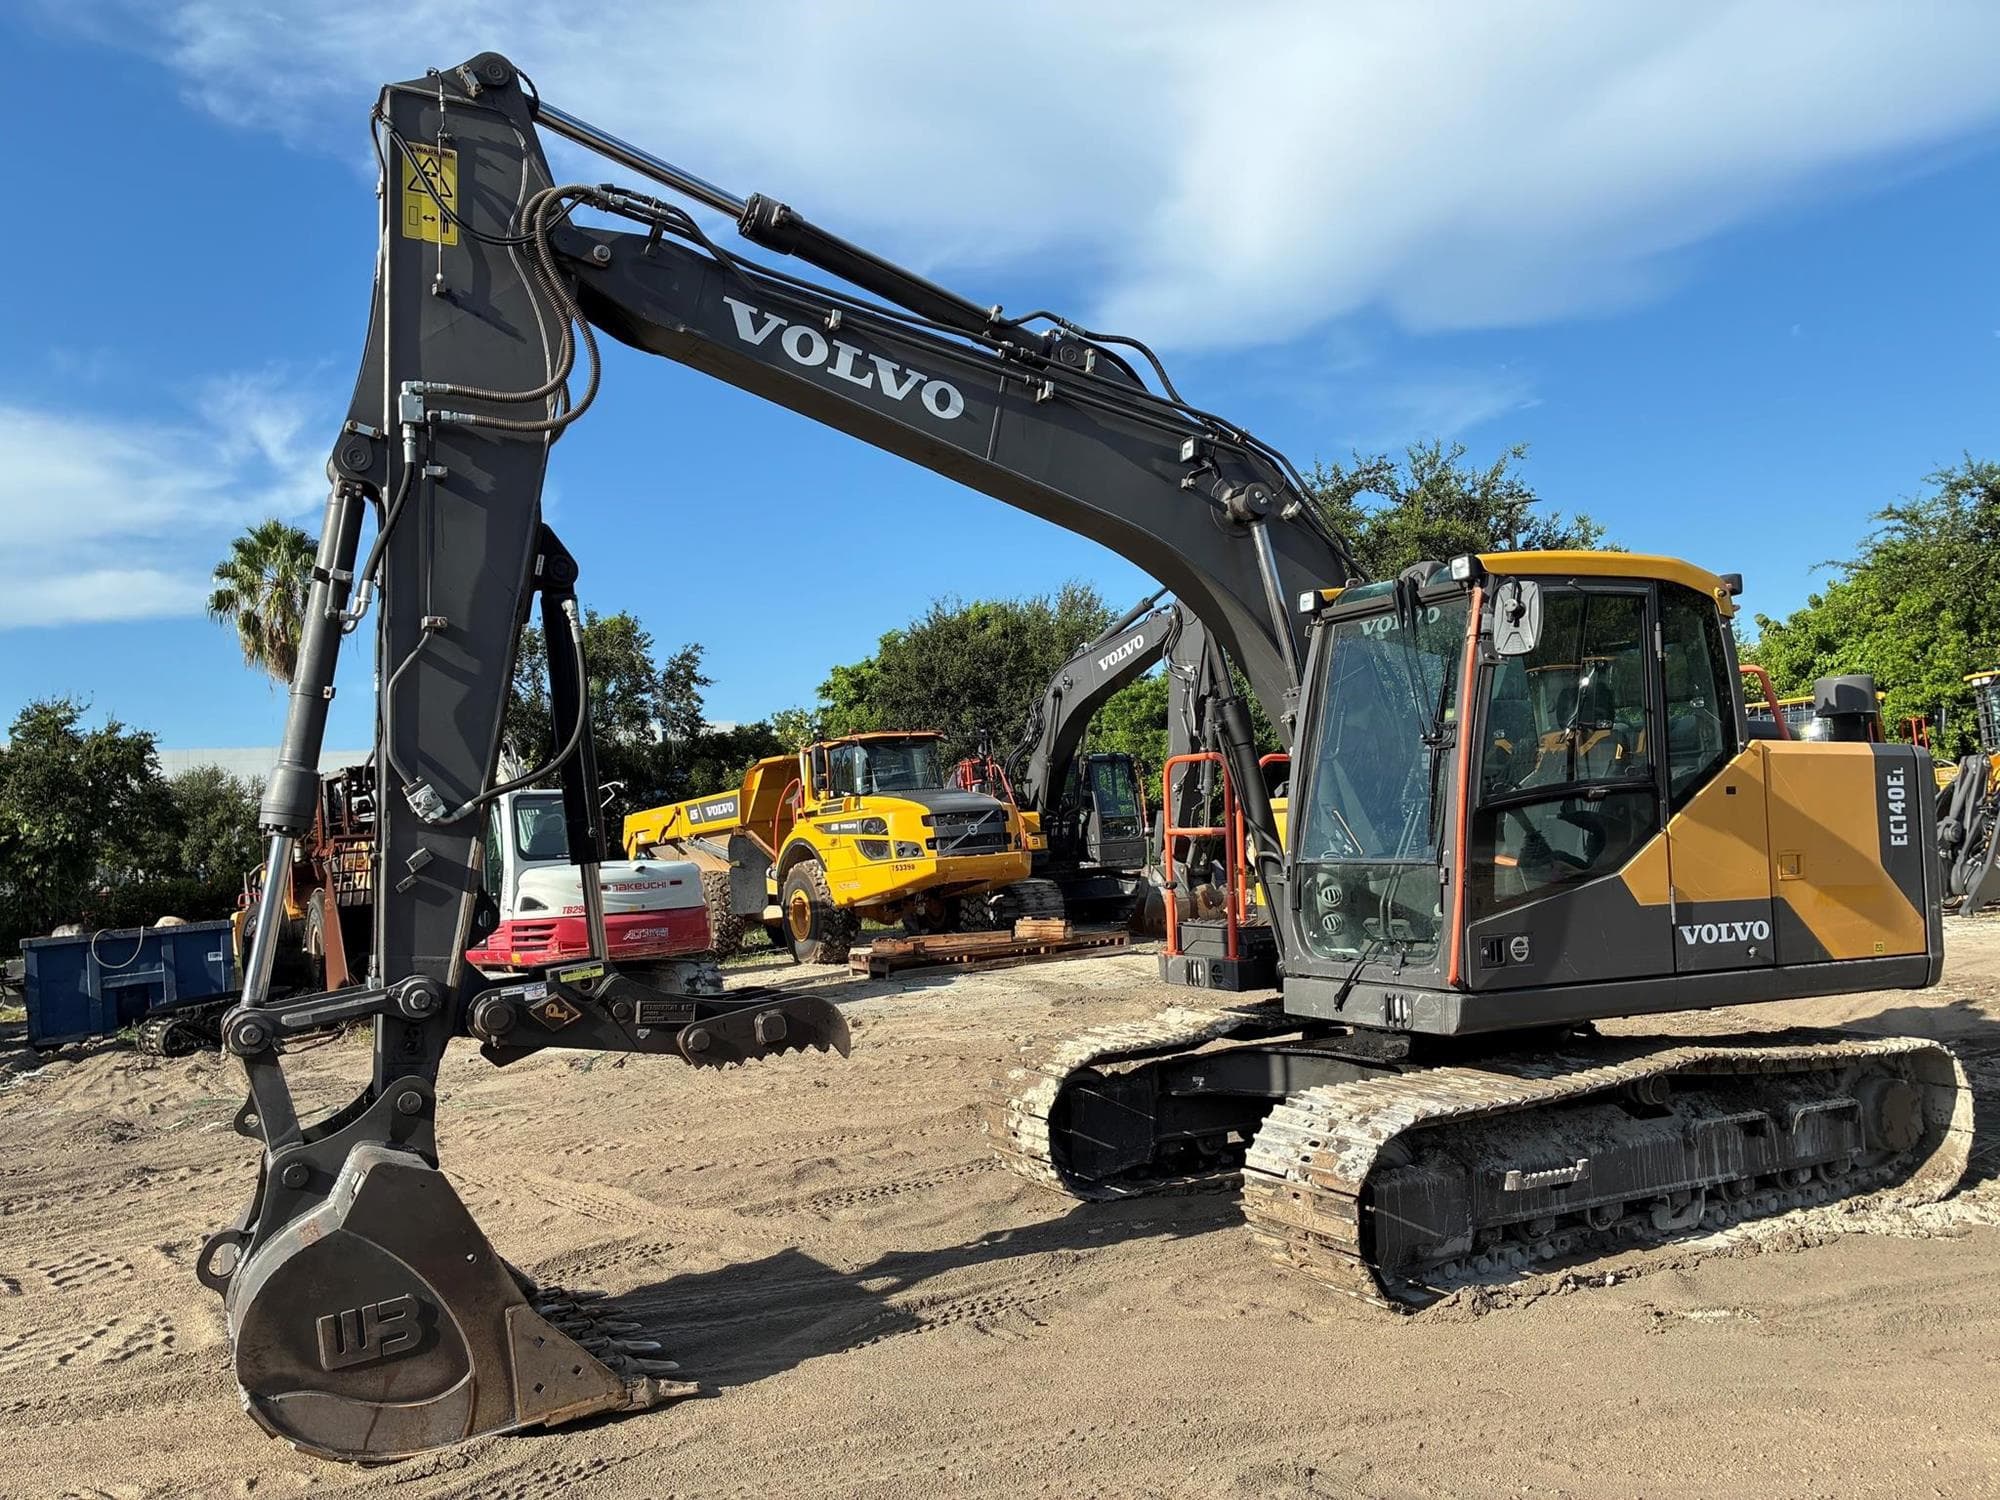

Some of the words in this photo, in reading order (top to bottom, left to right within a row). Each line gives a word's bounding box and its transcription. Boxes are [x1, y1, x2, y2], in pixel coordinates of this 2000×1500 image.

[722, 295, 966, 420] VOLVO
[1098, 634, 1145, 671] VOLVO
[705, 801, 735, 817] VOLVO
[1887, 767, 1909, 846] EC140EL
[1679, 920, 1771, 945] VOLVO
